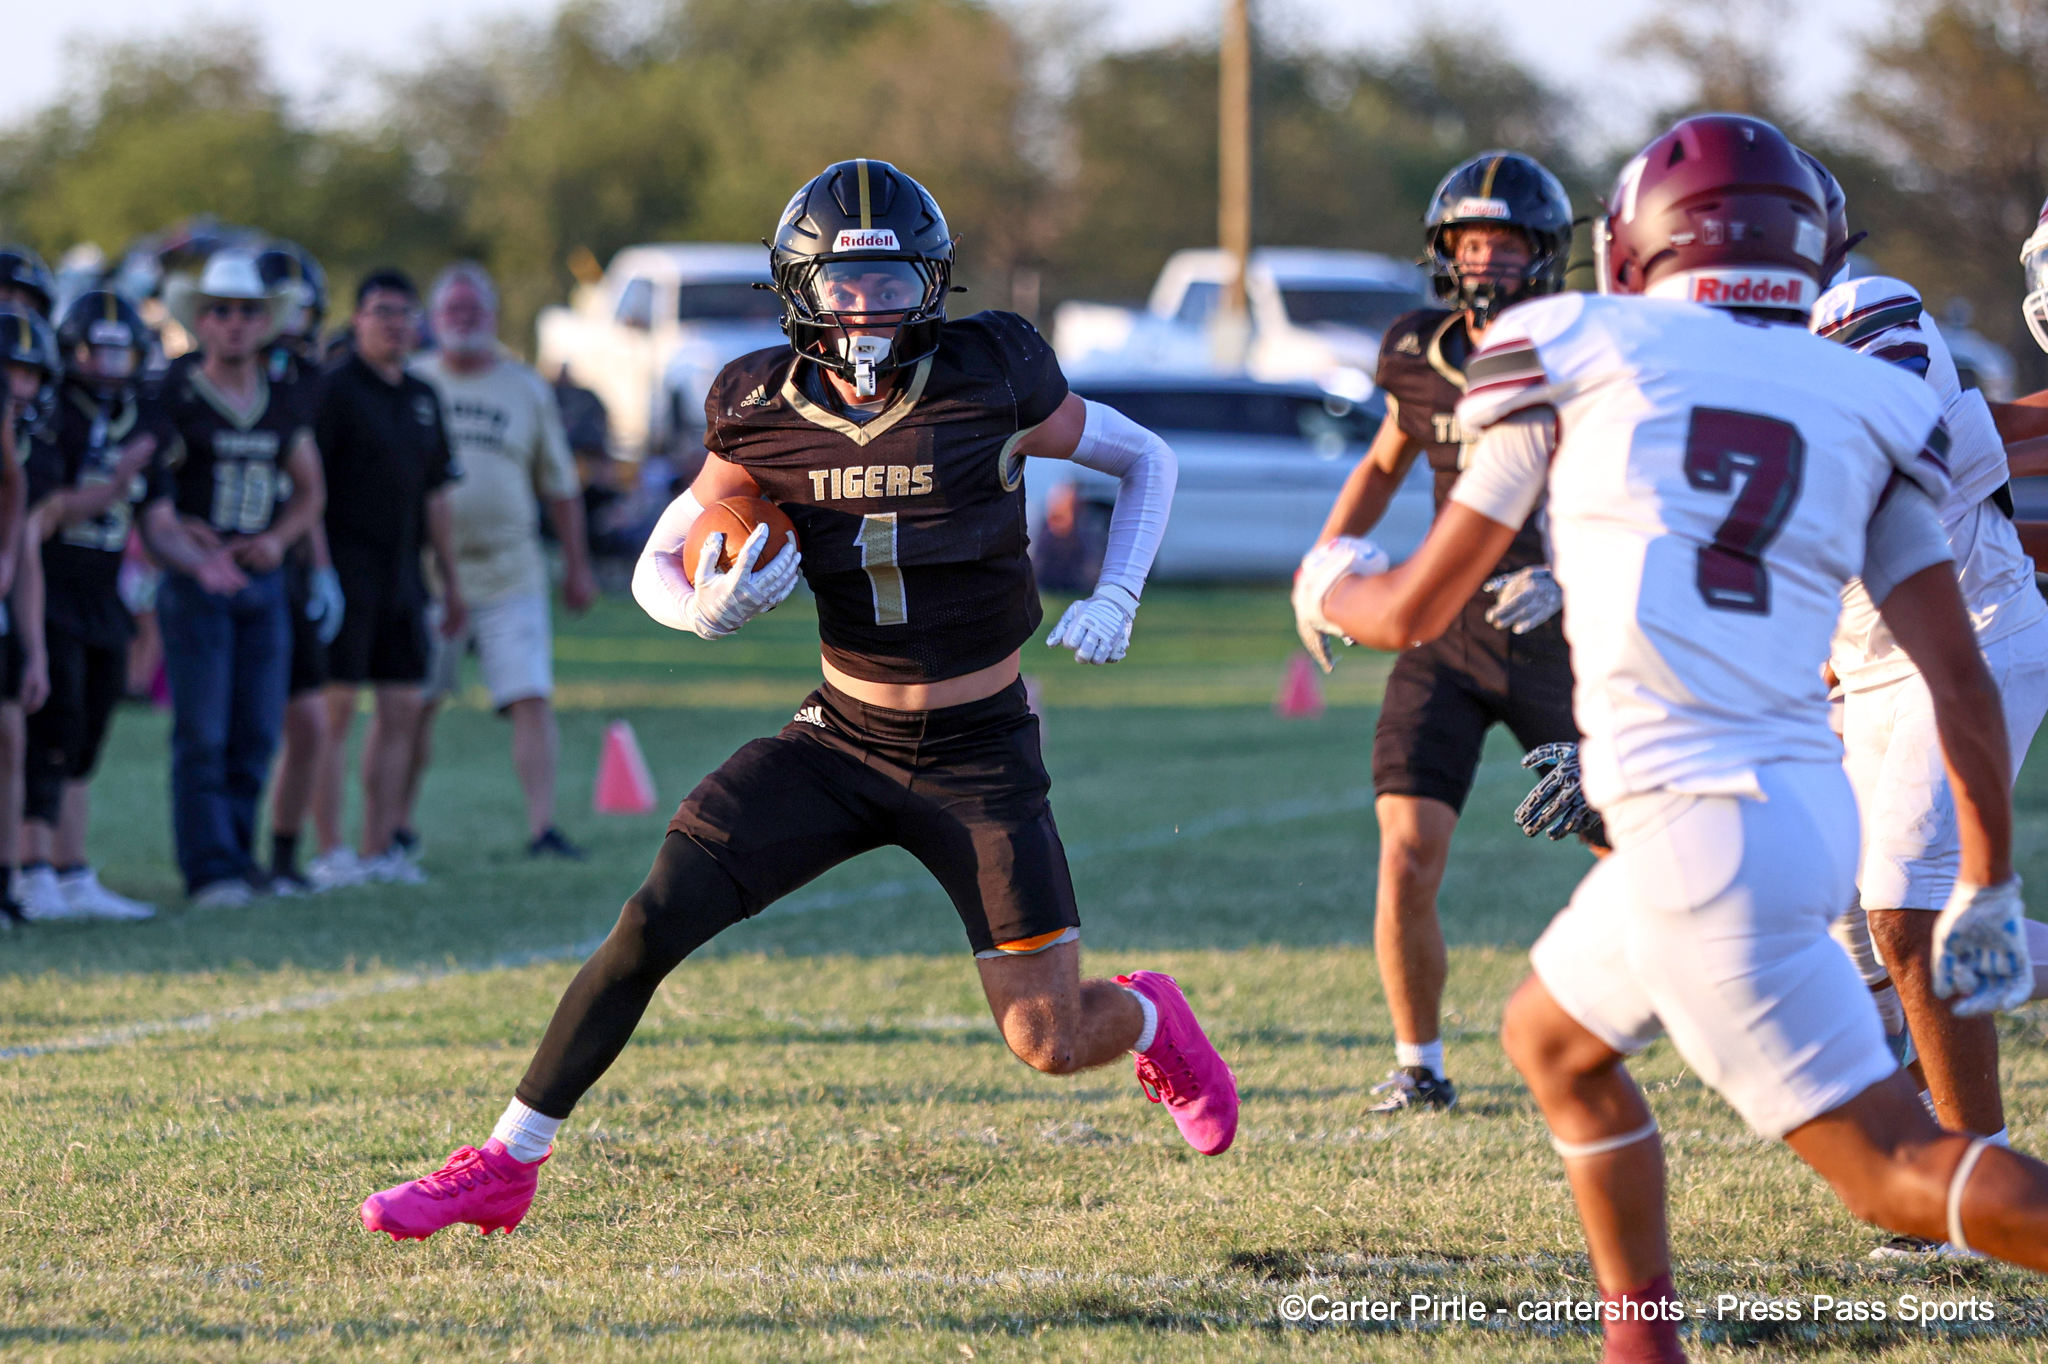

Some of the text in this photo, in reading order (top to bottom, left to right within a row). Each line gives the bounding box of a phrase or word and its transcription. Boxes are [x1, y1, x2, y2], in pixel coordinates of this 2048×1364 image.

[840, 235, 894, 247] Riddell
[1695, 277, 1803, 304] Riddell
[808, 463, 934, 502] TIGERS
[1683, 405, 1807, 616] 7
[853, 511, 908, 626] 1
